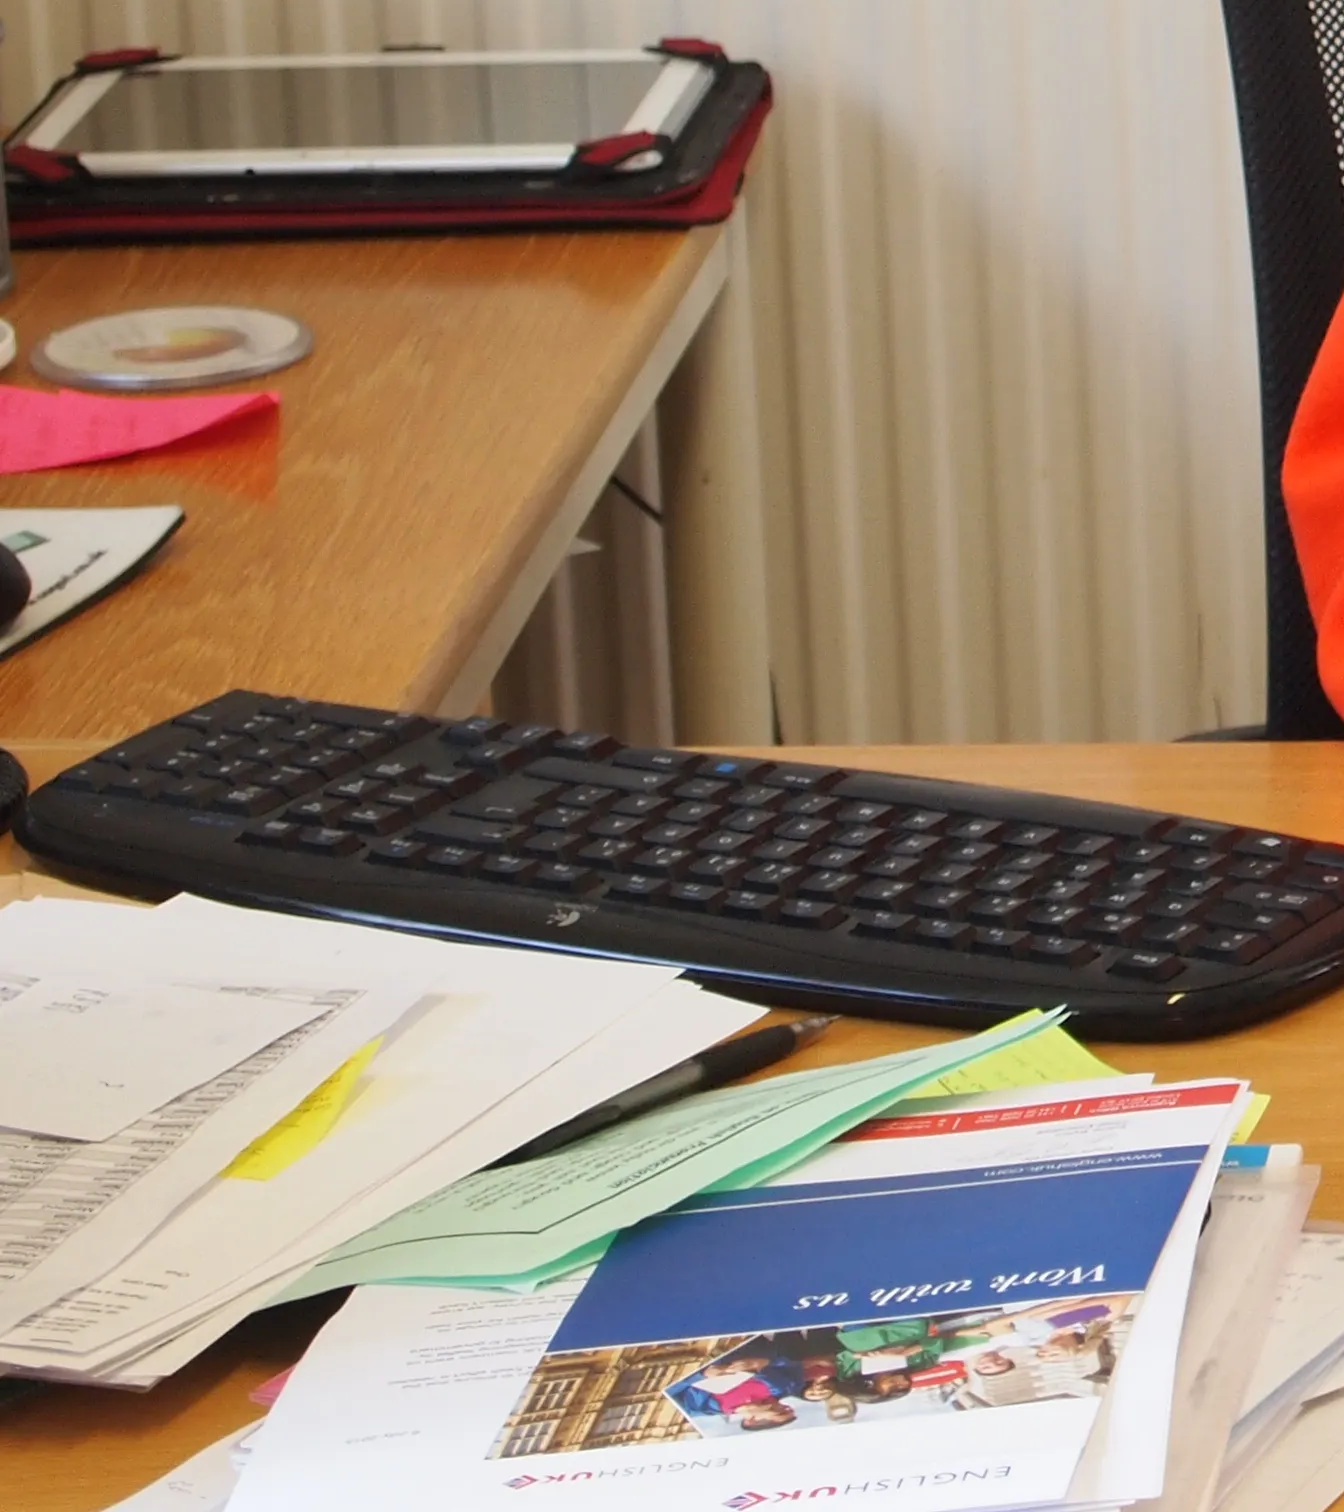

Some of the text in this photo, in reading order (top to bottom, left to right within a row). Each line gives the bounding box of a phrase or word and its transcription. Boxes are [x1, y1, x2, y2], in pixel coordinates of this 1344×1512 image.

[789, 1261, 1108, 1315] Work with us
